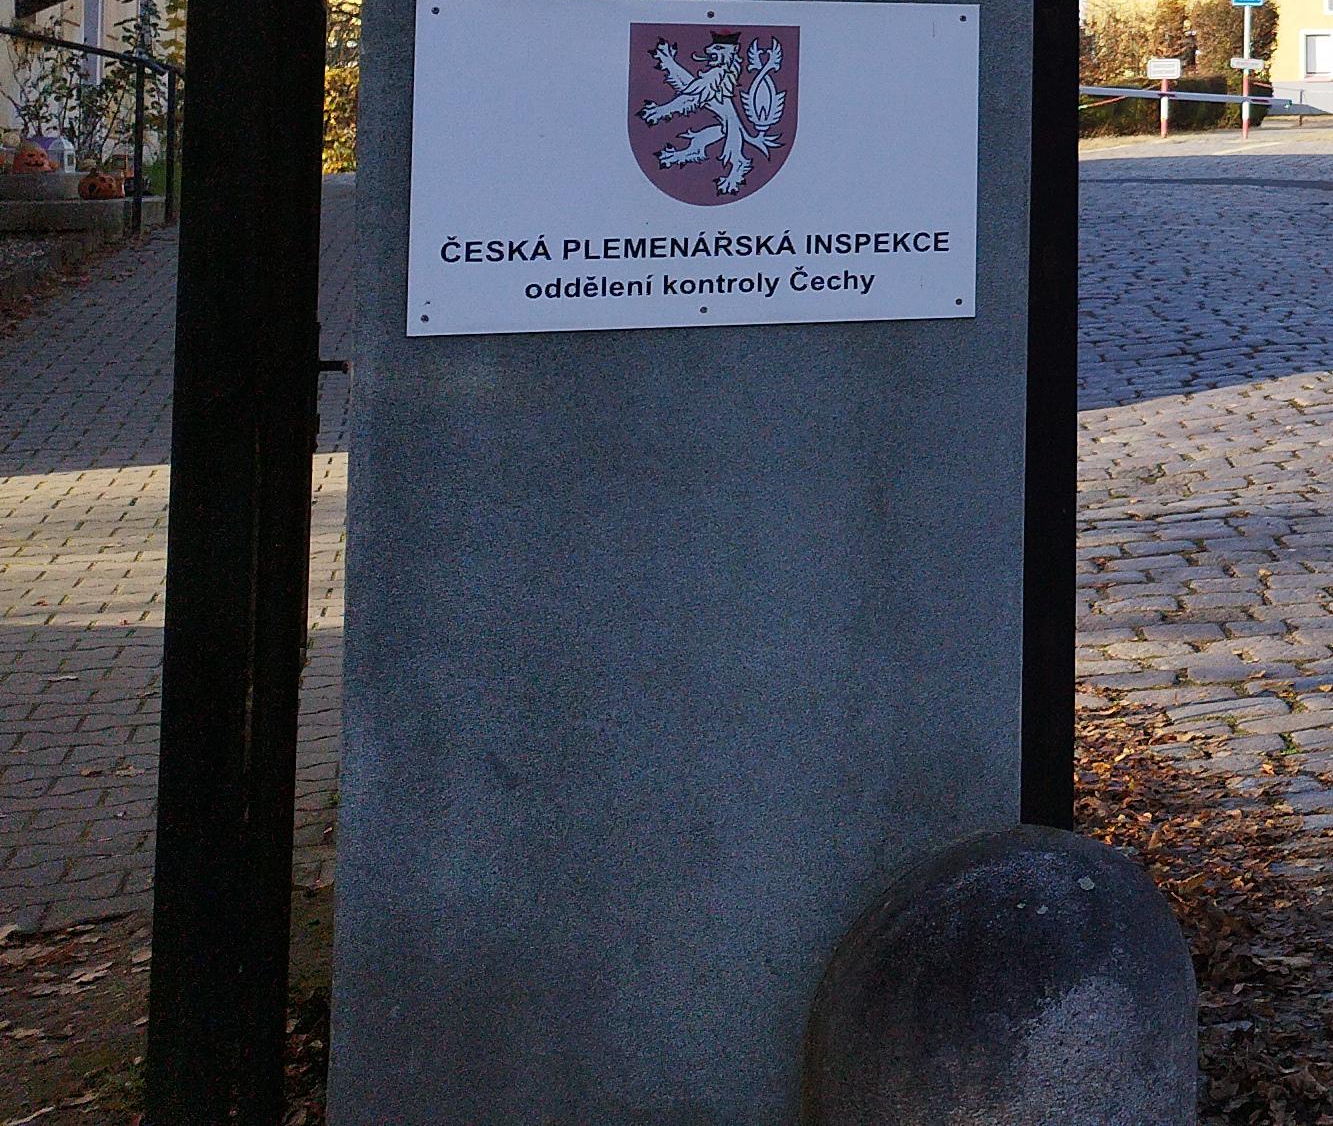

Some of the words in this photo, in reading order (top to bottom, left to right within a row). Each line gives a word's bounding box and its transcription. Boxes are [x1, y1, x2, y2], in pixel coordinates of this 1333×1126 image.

[440, 234, 552, 263] ČESKÁ
[562, 229, 796, 260] PLEMENÁŘSKÁ
[806, 231, 950, 255] INSPEKCE
[524, 273, 653, 300] oddělení
[663, 272, 779, 300] kontroly
[790, 266, 875, 296] Čechy
